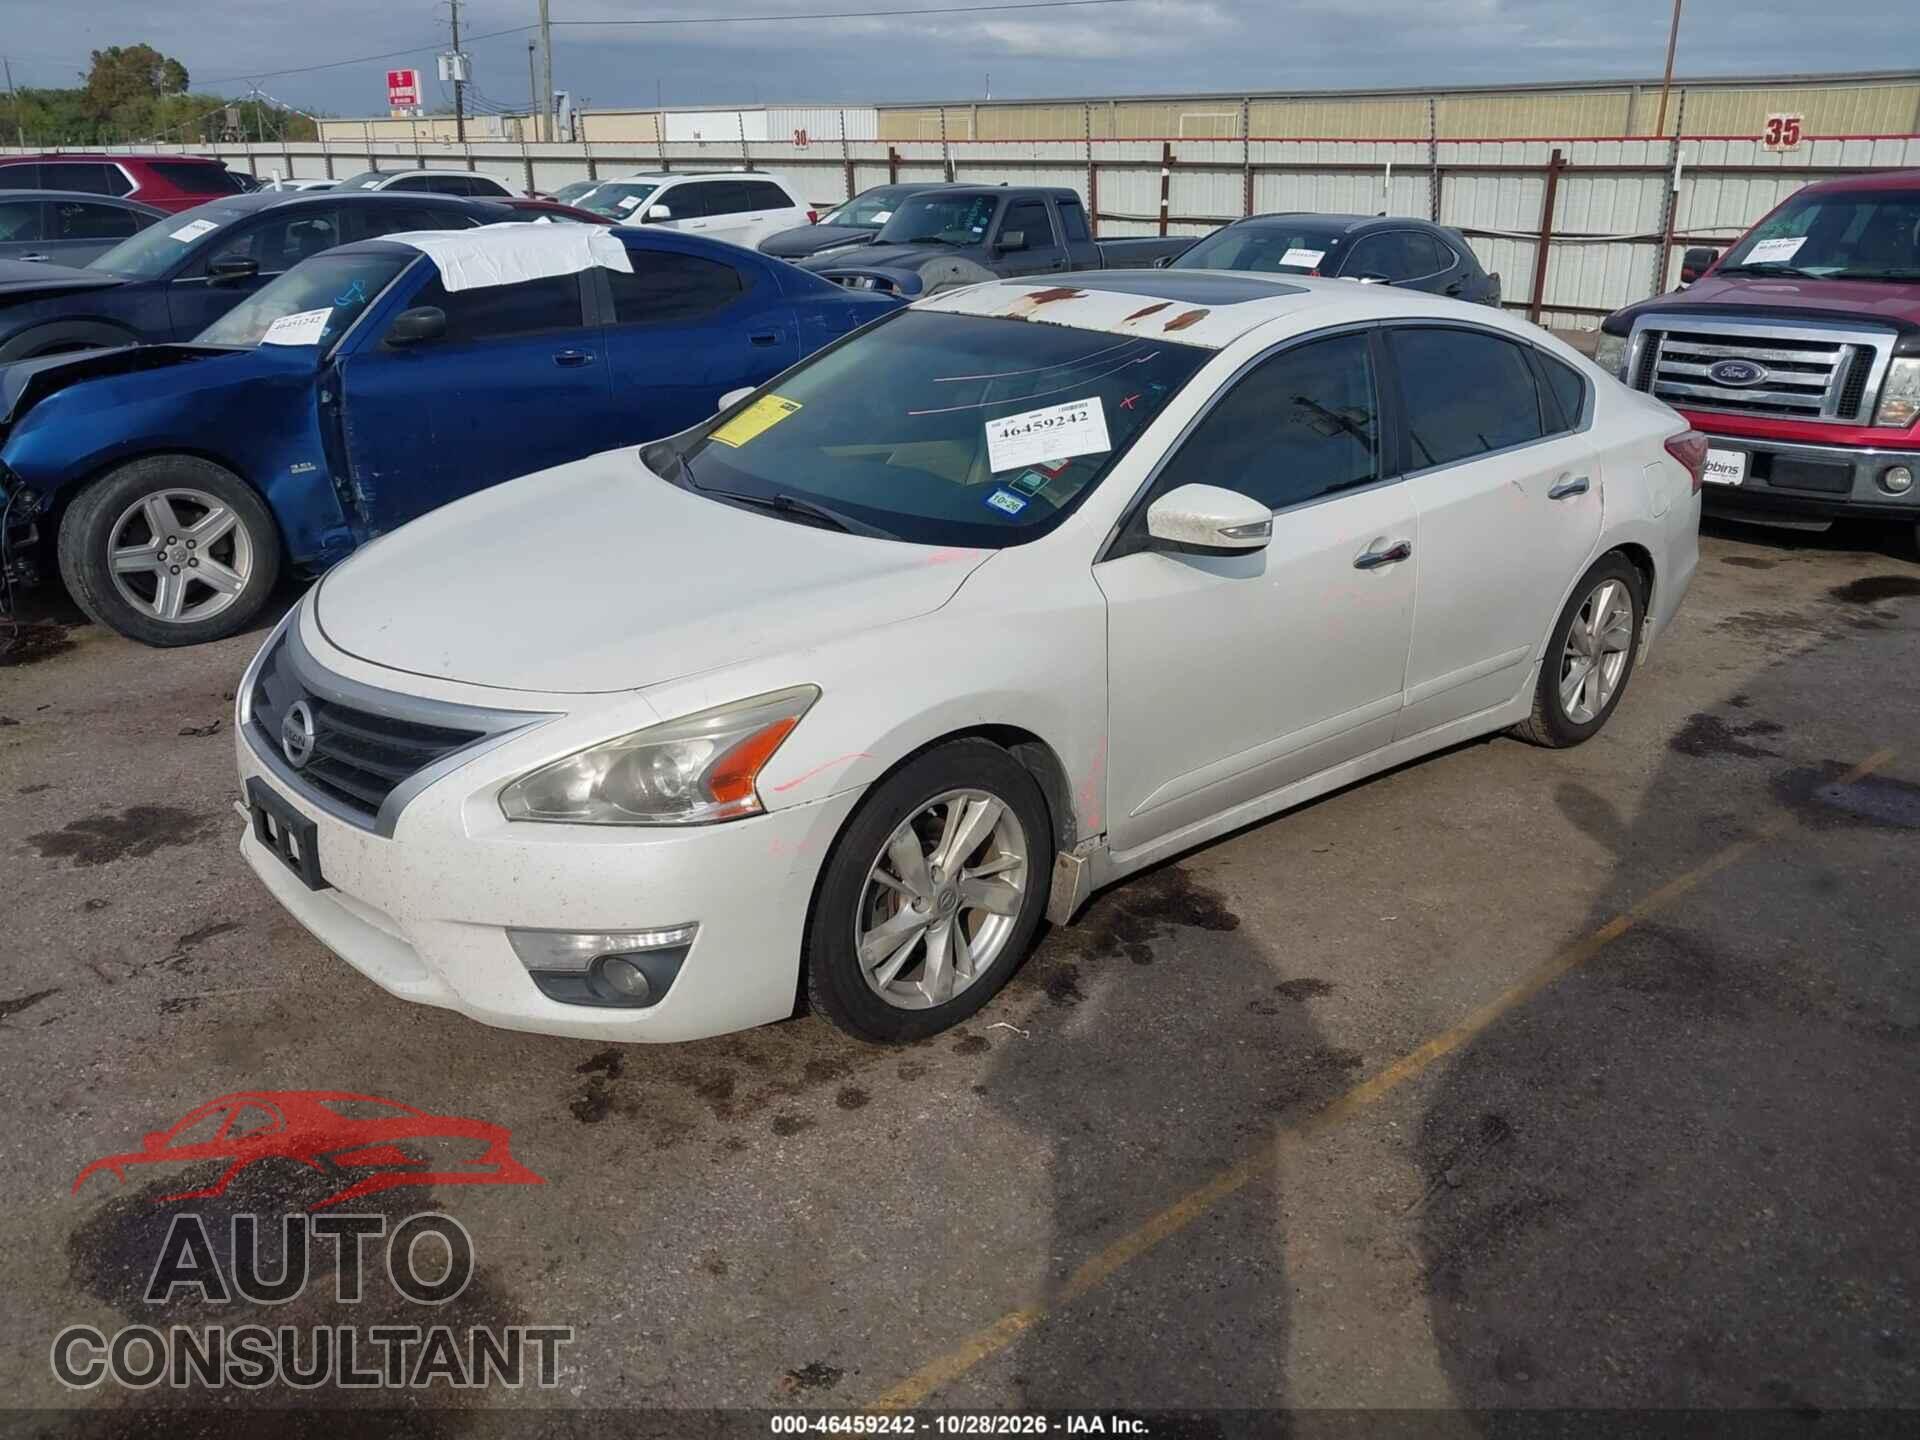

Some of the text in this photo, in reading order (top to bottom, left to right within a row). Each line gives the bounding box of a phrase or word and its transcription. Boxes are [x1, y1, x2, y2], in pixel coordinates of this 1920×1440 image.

[794, 129, 807, 146] 30
[1765, 118, 1801, 146] 35
[1720, 365, 1752, 378] Ford
[999, 411, 1089, 439] 46459242
